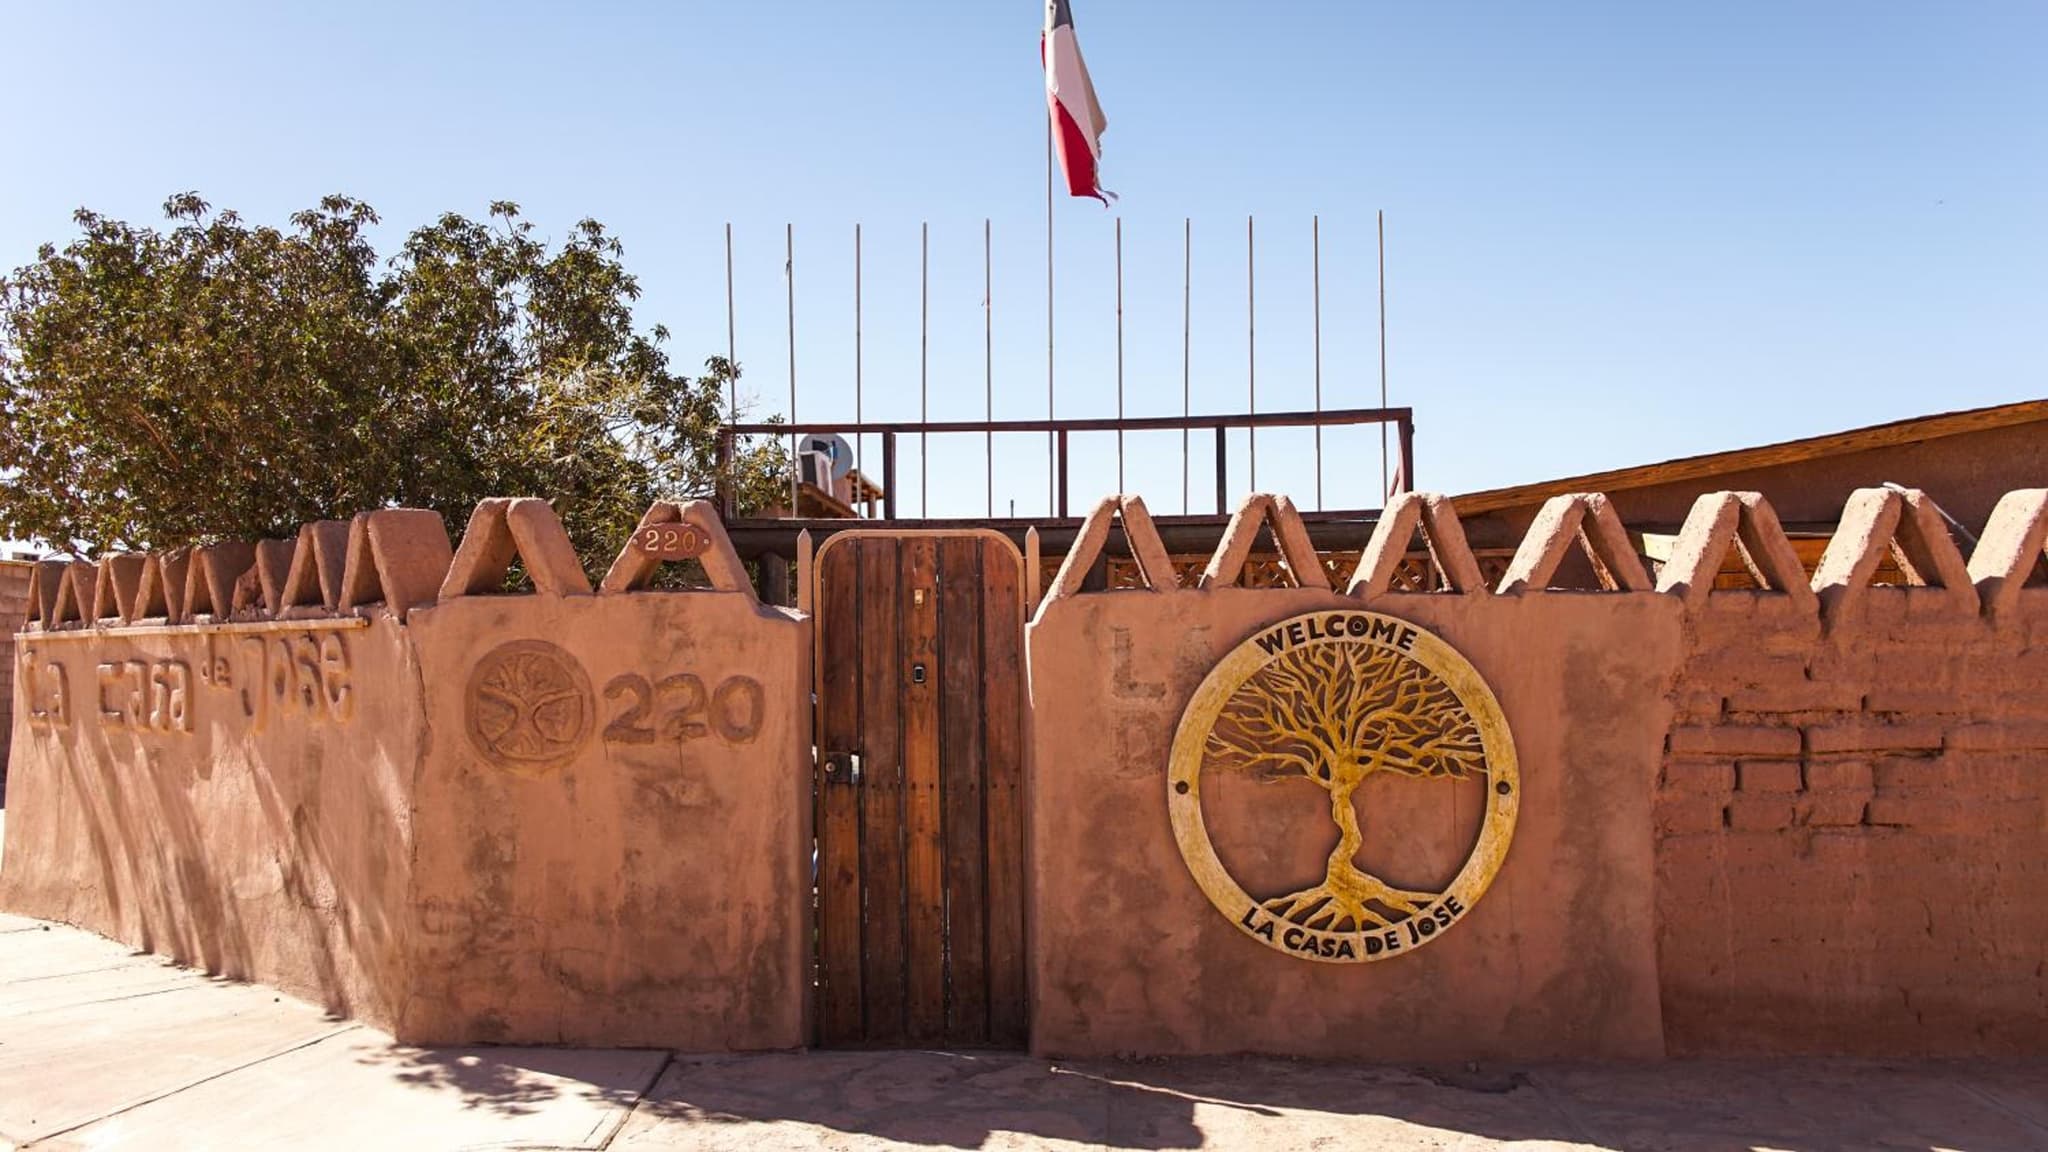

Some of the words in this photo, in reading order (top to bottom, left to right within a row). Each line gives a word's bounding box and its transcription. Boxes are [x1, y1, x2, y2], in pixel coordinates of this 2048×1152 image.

[645, 529, 697, 551] 220
[1256, 615, 1417, 655] WELCOME
[603, 673, 764, 744] 220
[1242, 907, 1275, 940] LA
[1283, 928, 1355, 959] CASA
[1365, 931, 1400, 955] DE
[1405, 895, 1464, 944] JOSE
